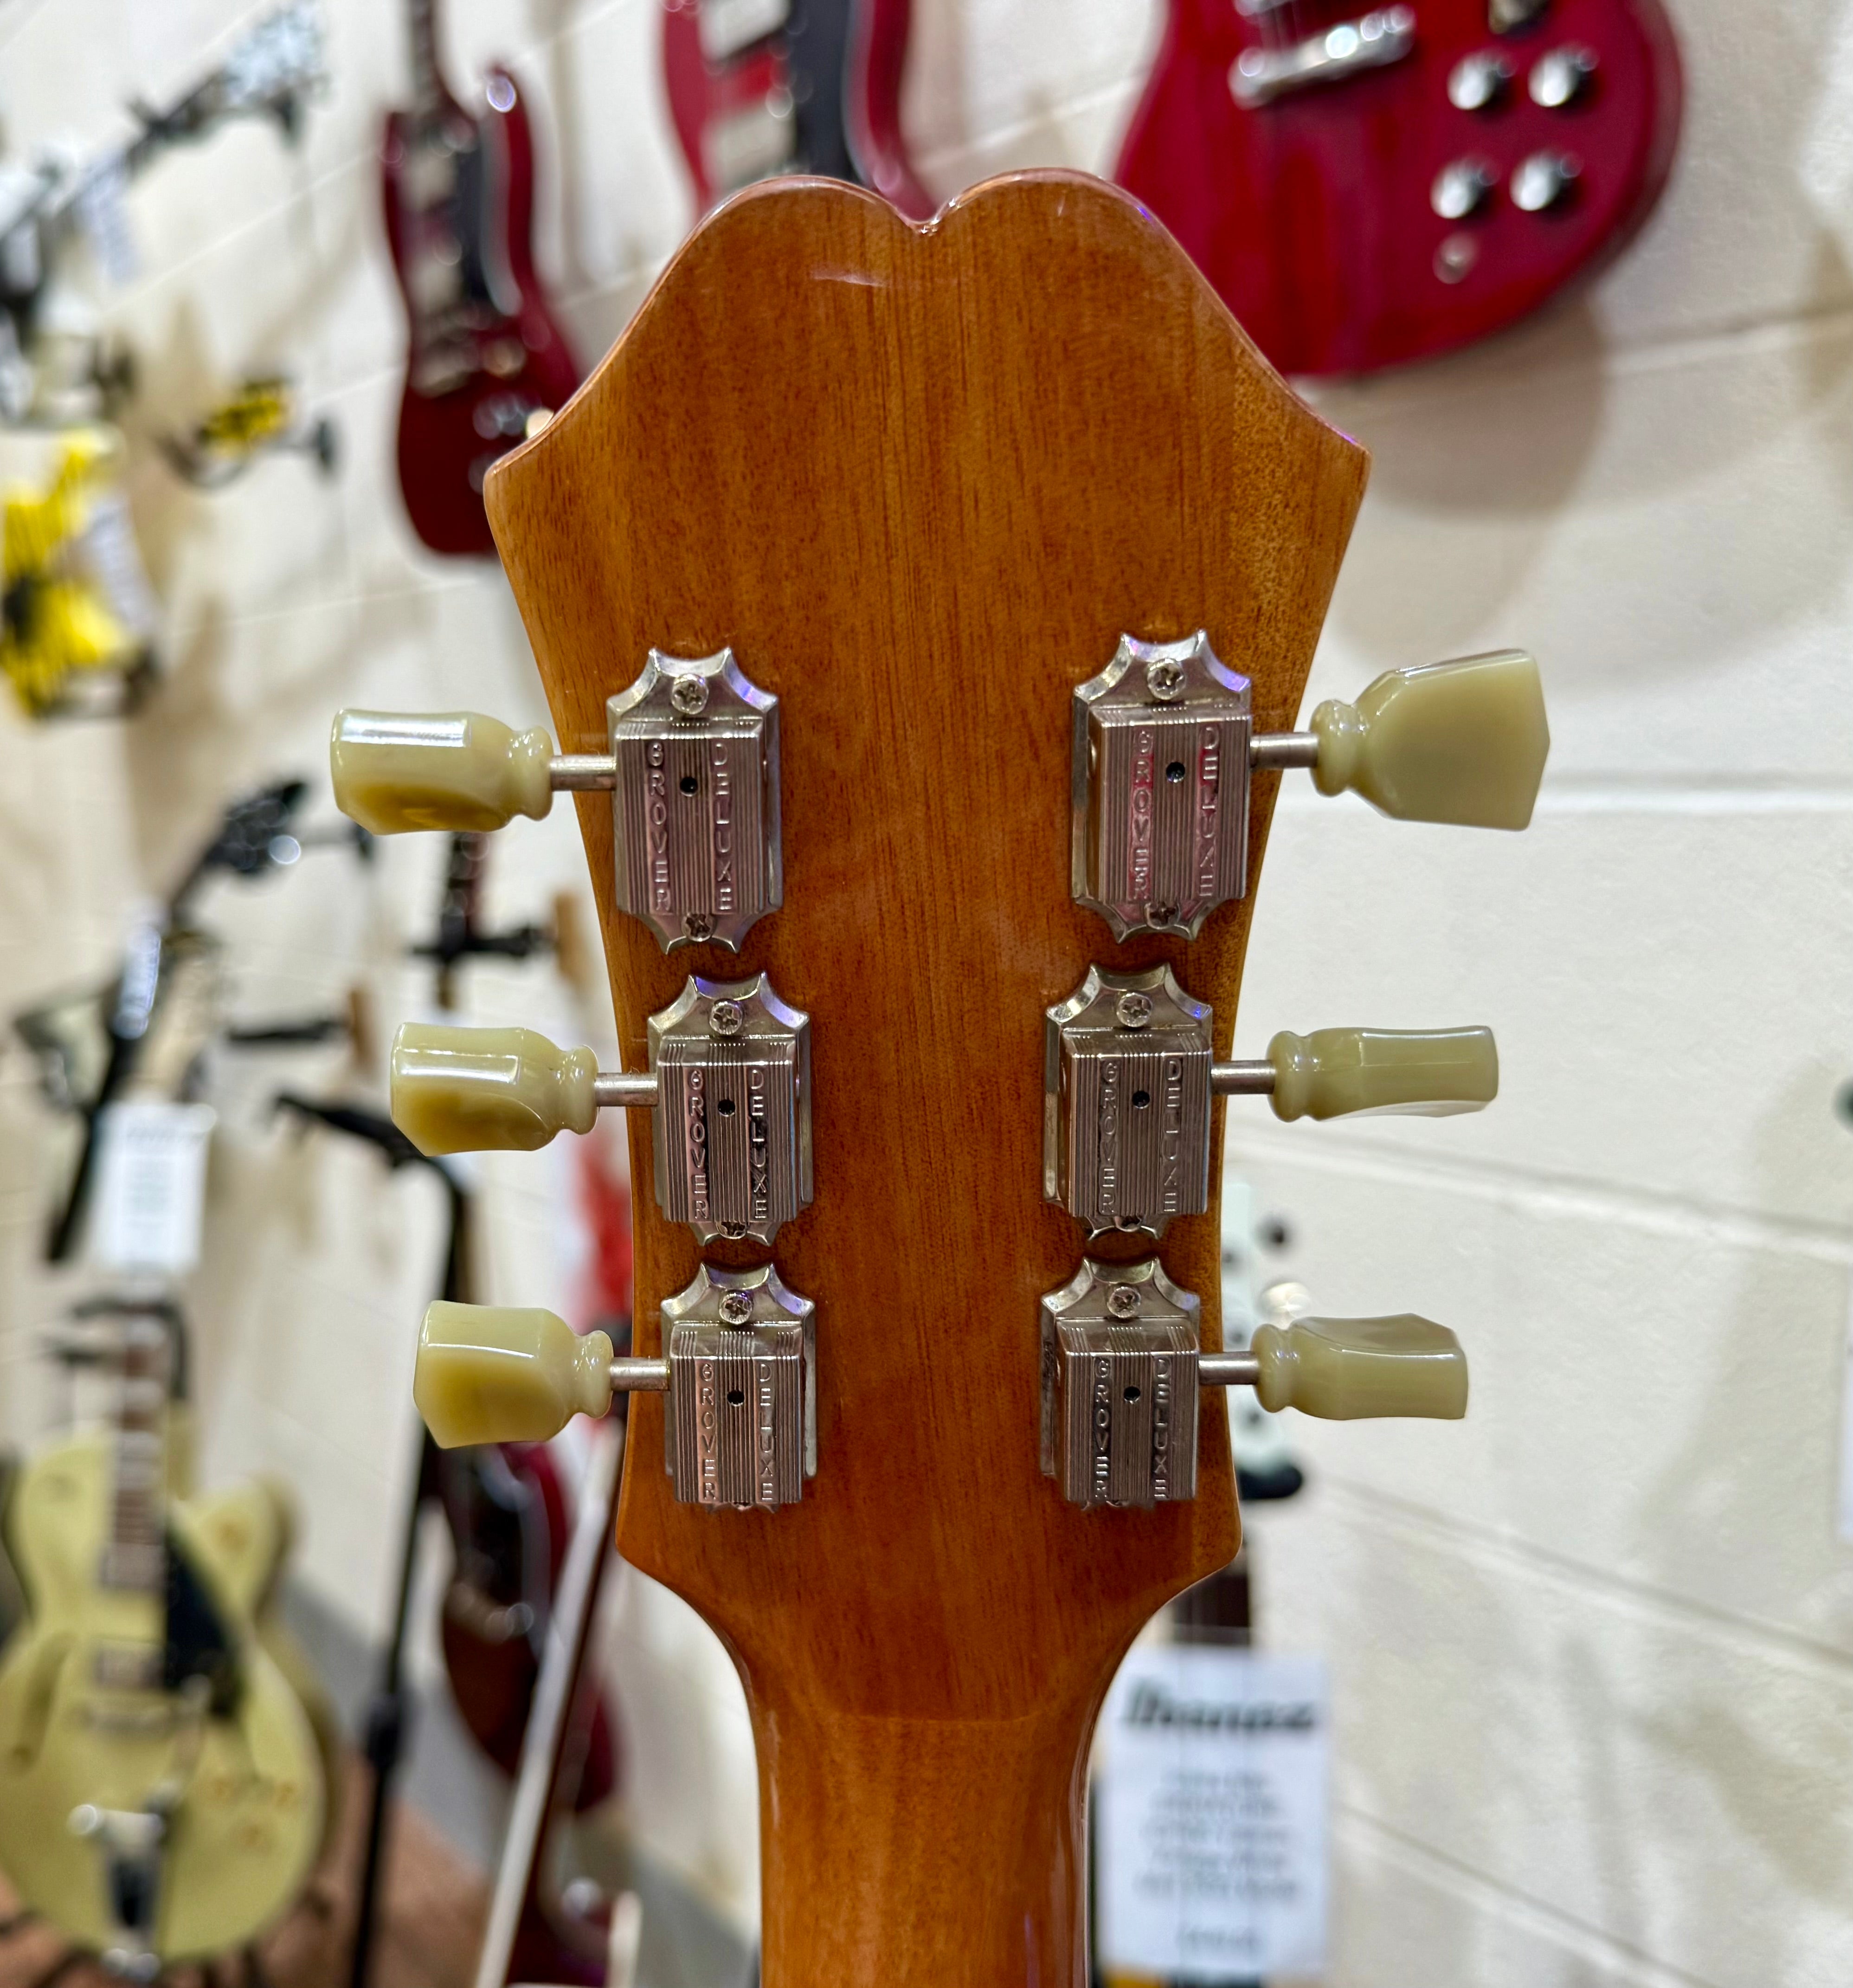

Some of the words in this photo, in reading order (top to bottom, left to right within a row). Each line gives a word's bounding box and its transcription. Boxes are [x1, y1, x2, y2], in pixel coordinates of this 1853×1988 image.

[650, 742, 670, 911] GROVER
[714, 743, 732, 910] DELUXE
[1133, 730, 1151, 900] GROVER
[1199, 727, 1219, 897] DELUXE
[689, 1070, 709, 1219] GROVER
[751, 1070, 766, 1219] DELUXE
[1102, 1063, 1118, 1213] GROVER
[1163, 1061, 1181, 1212] DELUXE
[700, 1364, 716, 1500] GROVER
[759, 1364, 773, 1500] DELUXE
[1095, 1359, 1111, 1499] GROVER
[1153, 1358, 1171, 1499] DELUXE
